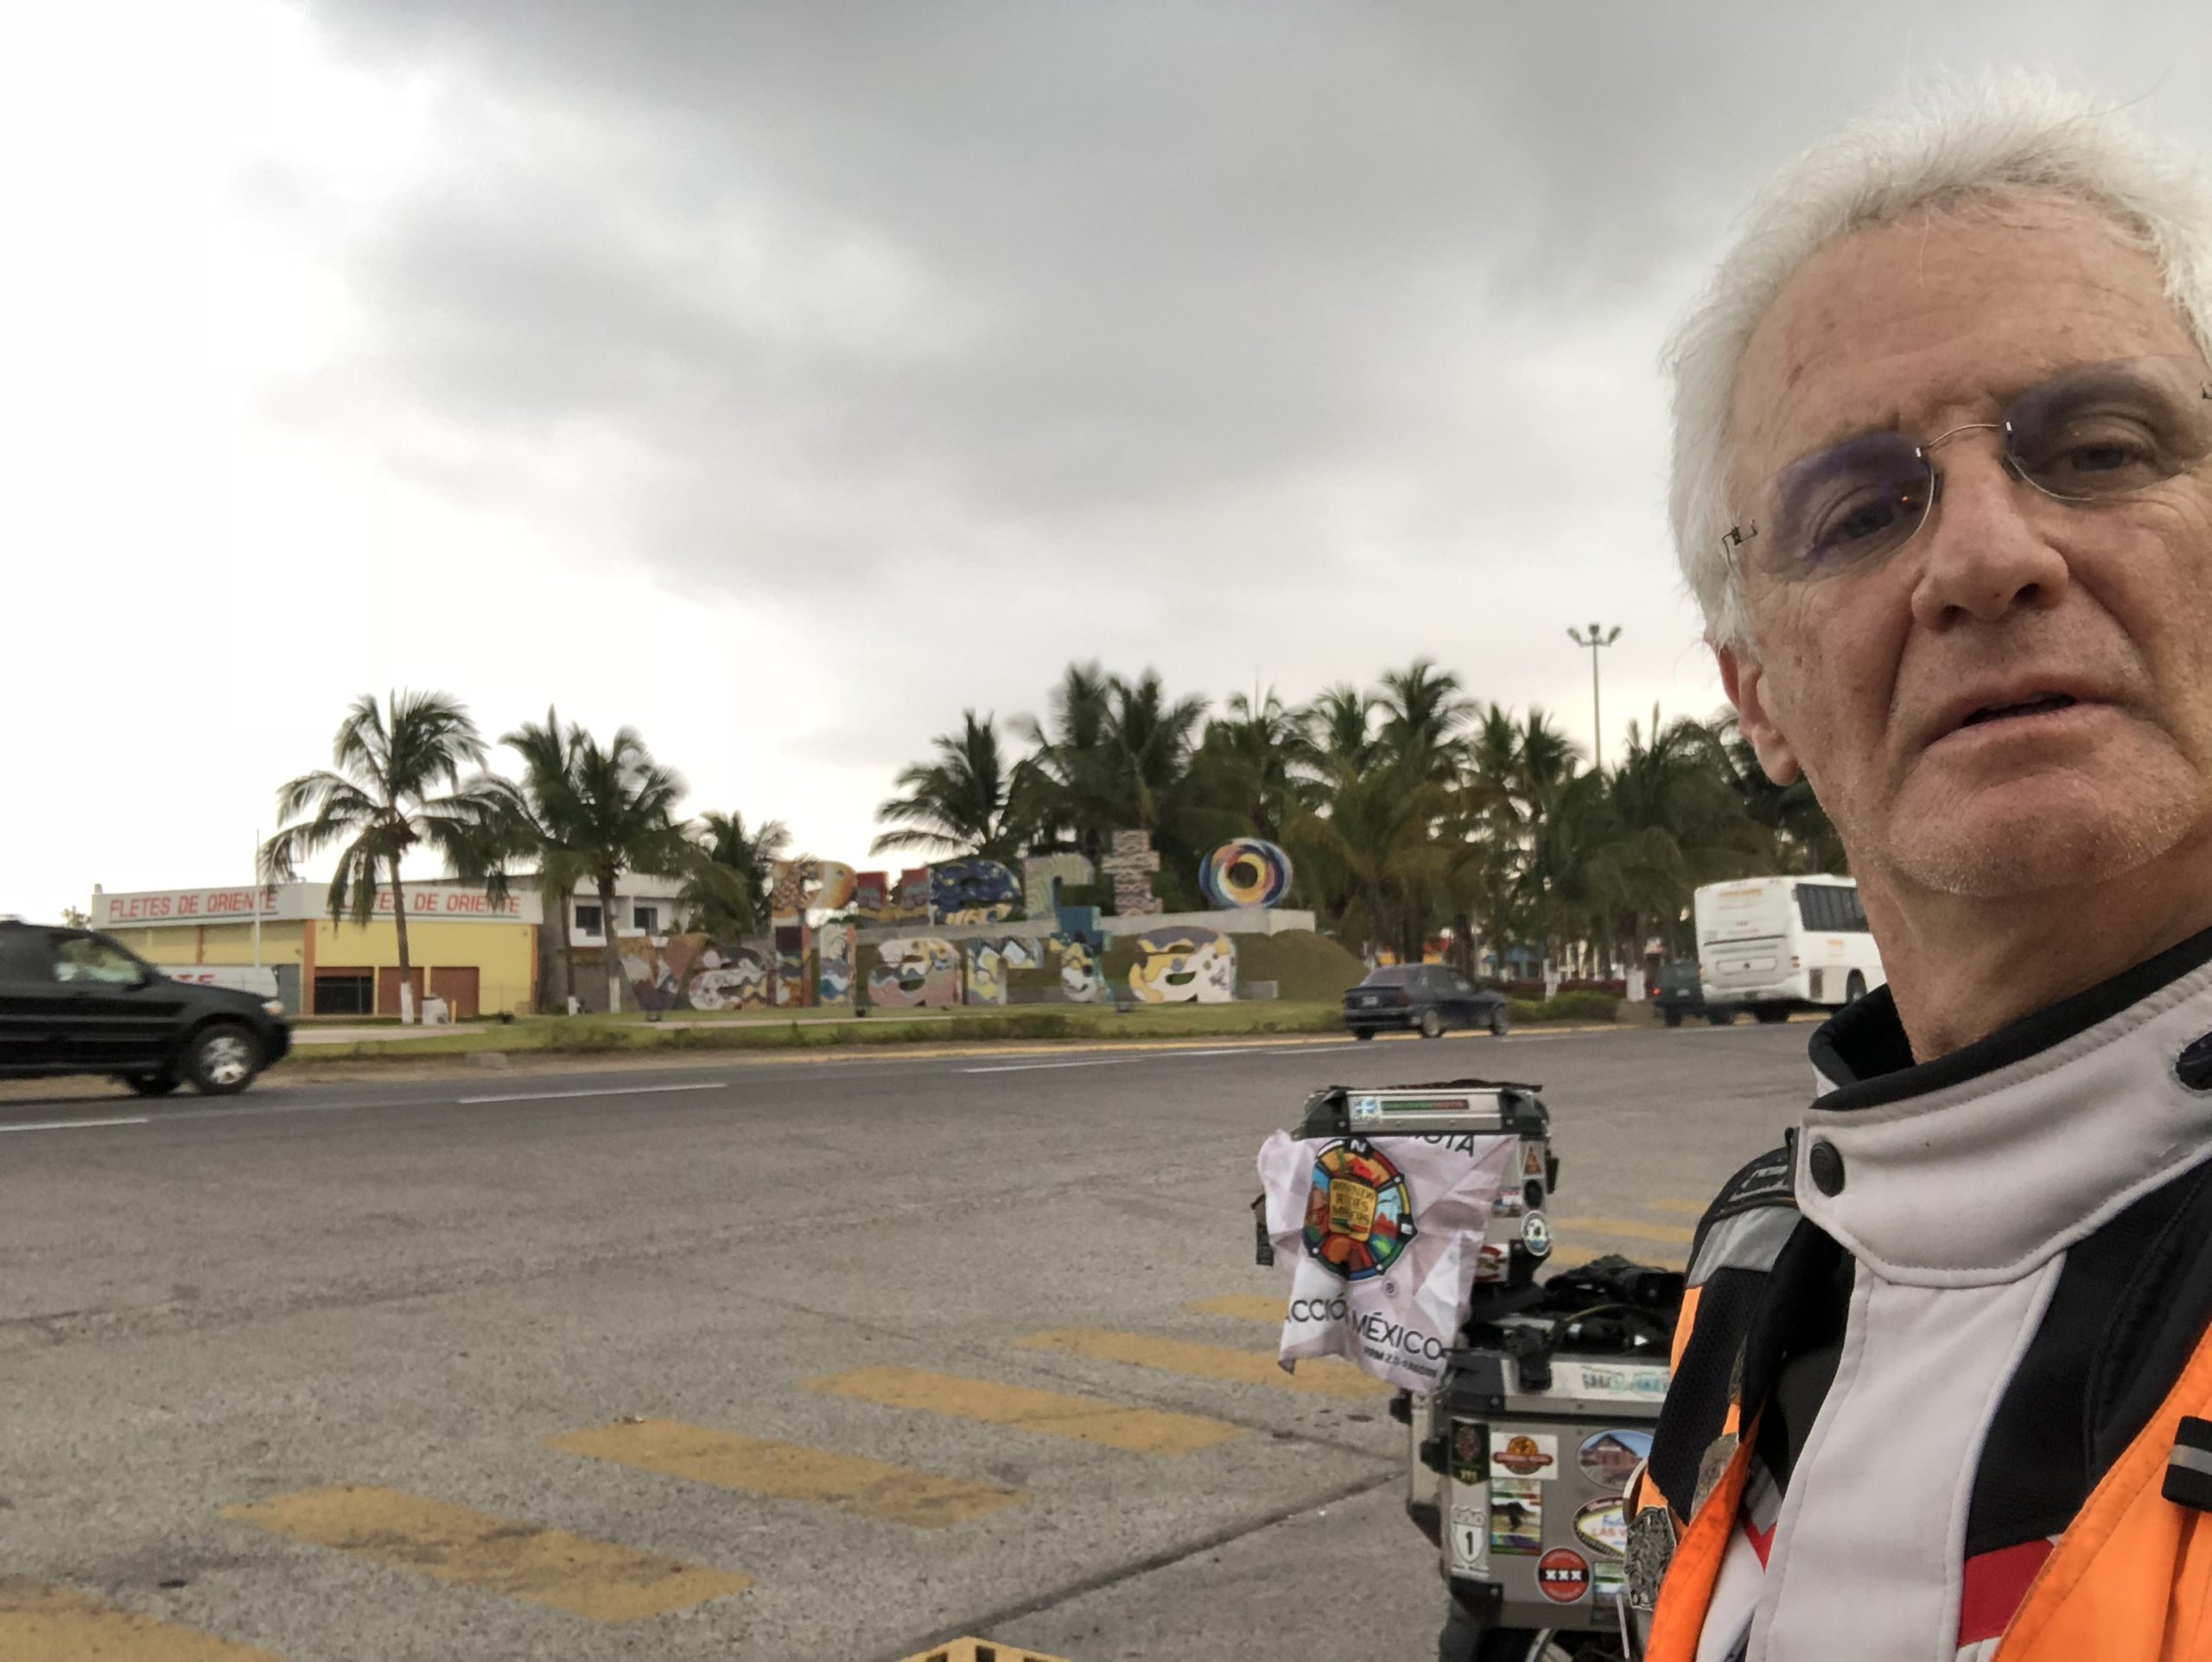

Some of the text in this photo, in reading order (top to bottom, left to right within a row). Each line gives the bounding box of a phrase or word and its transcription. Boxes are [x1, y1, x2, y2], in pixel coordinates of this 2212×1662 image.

[109, 889, 279, 919] FLETES DE ORIENTE
[414, 892, 439, 912] DE
[1351, 1310, 1443, 1361] MÉXICO
